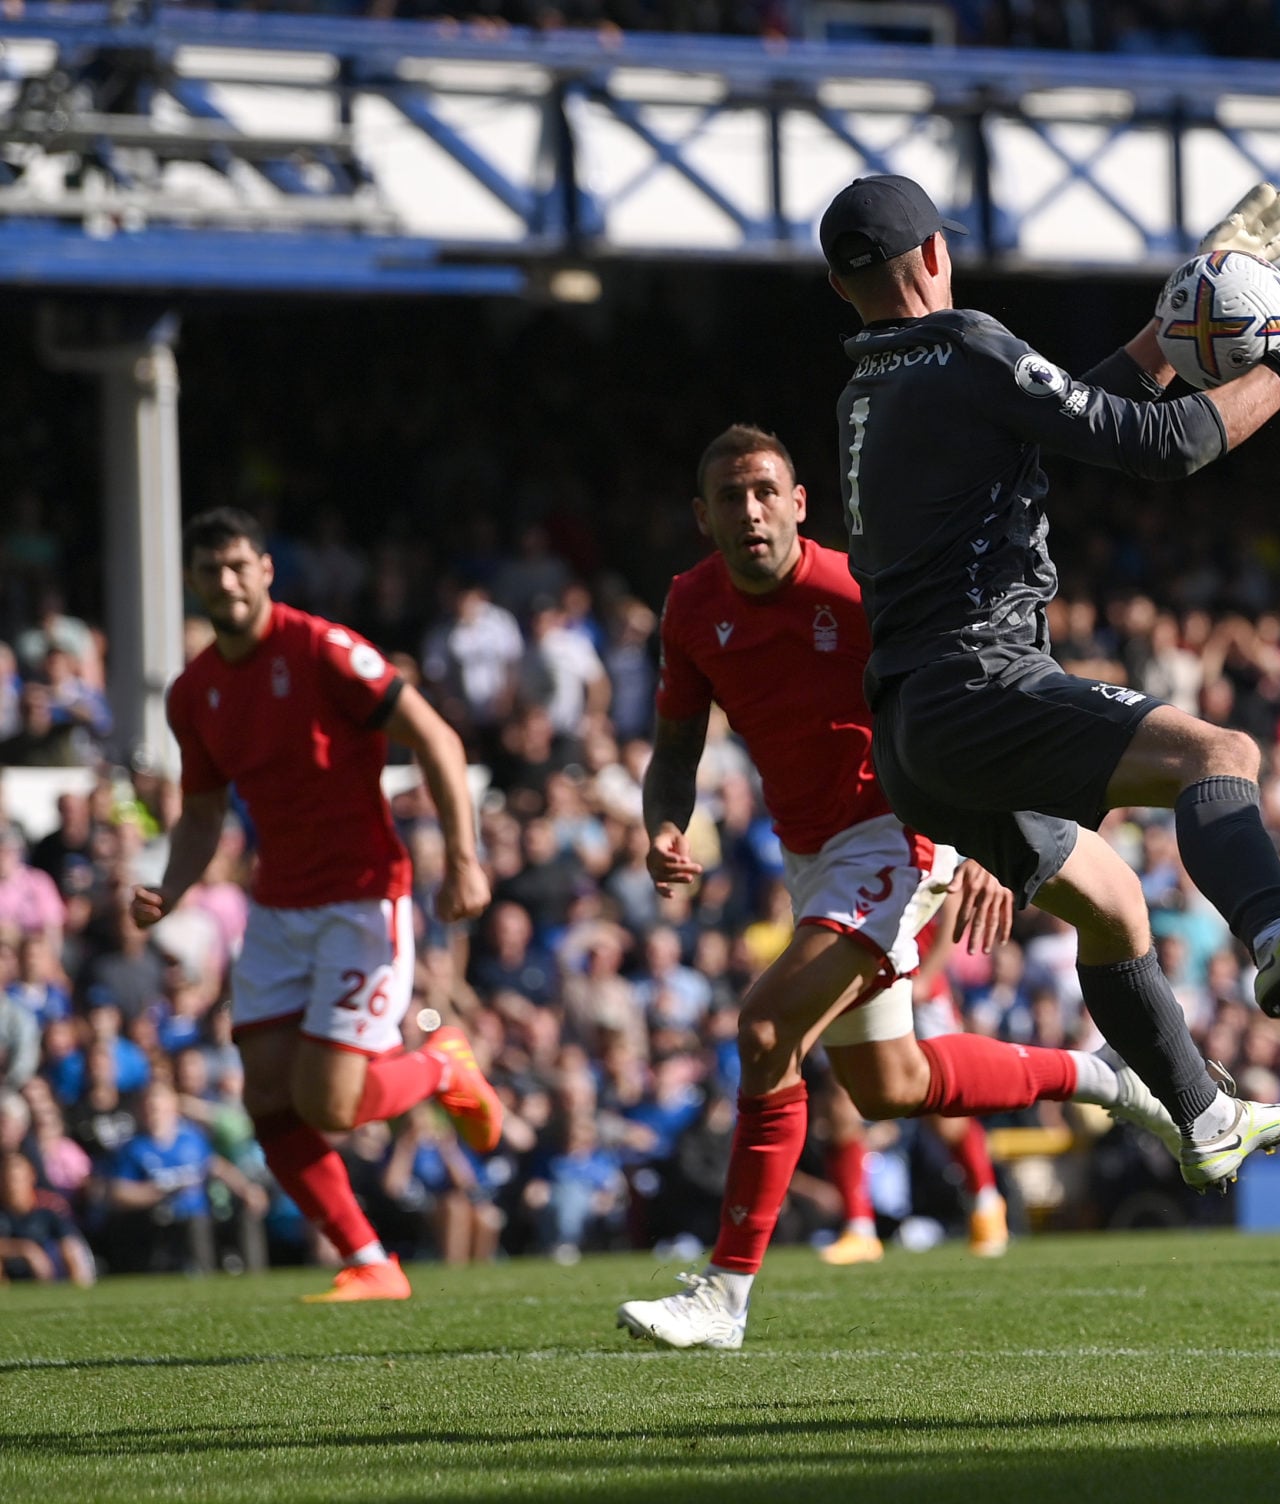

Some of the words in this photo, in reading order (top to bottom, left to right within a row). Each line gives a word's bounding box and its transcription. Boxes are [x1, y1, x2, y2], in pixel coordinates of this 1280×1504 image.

[854, 342, 952, 379] DERSON
[848, 397, 871, 535] 1
[857, 865, 898, 902] 3
[333, 968, 389, 1017] 26
